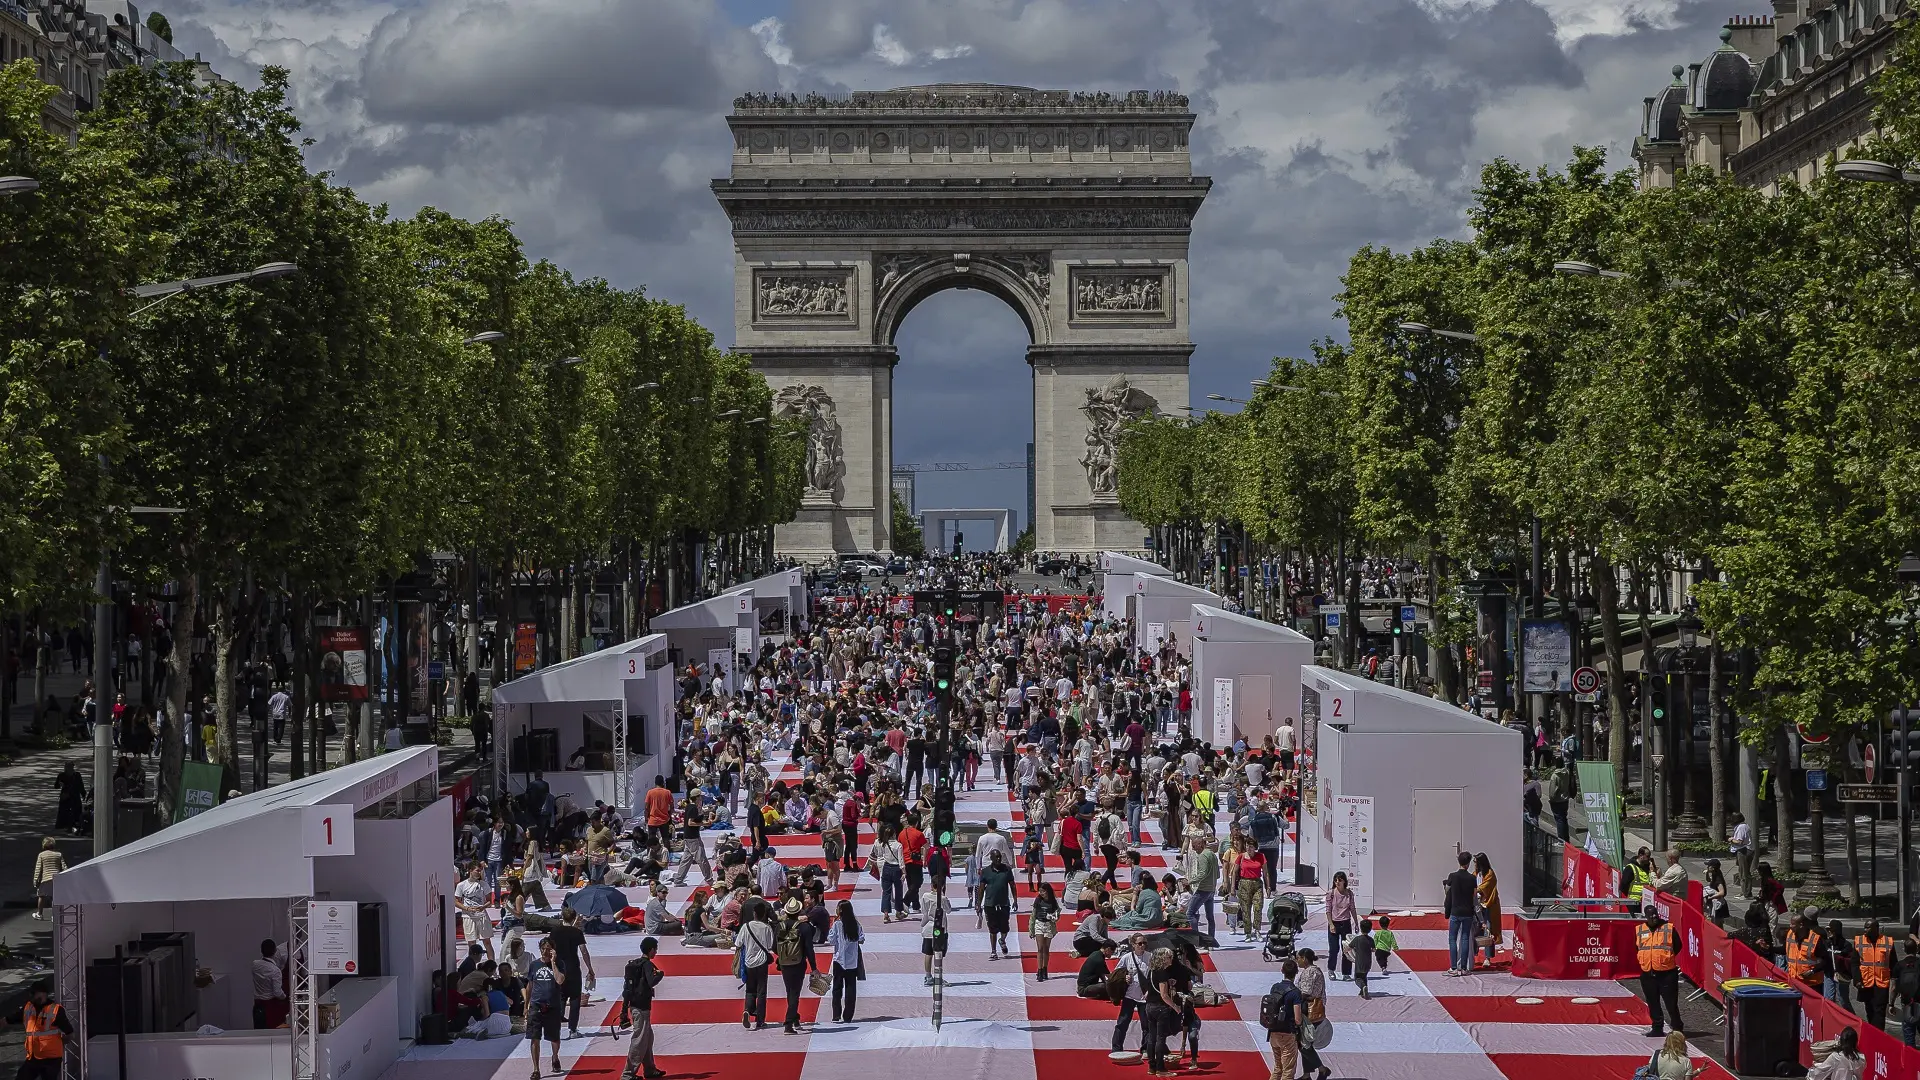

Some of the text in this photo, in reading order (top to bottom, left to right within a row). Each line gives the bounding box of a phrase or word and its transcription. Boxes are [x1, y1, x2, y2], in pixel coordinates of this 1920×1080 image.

[1105, 559, 1110, 567] 8
[791, 575, 796, 583] 7
[1138, 582, 1143, 590] 6
[740, 600, 746, 609] 5
[1197, 620, 1204, 632] 4
[628, 659, 636, 674] 3
[1578, 675, 1594, 687] 50
[1333, 698, 1342, 717] 2
[322, 817, 333, 845] 1
[1586, 937, 1601, 947] ICI,
[1578, 947, 1610, 955] ON BOIT
[1806, 1016, 1814, 1043] LG
[1874, 1051, 1888, 1078] Life's
